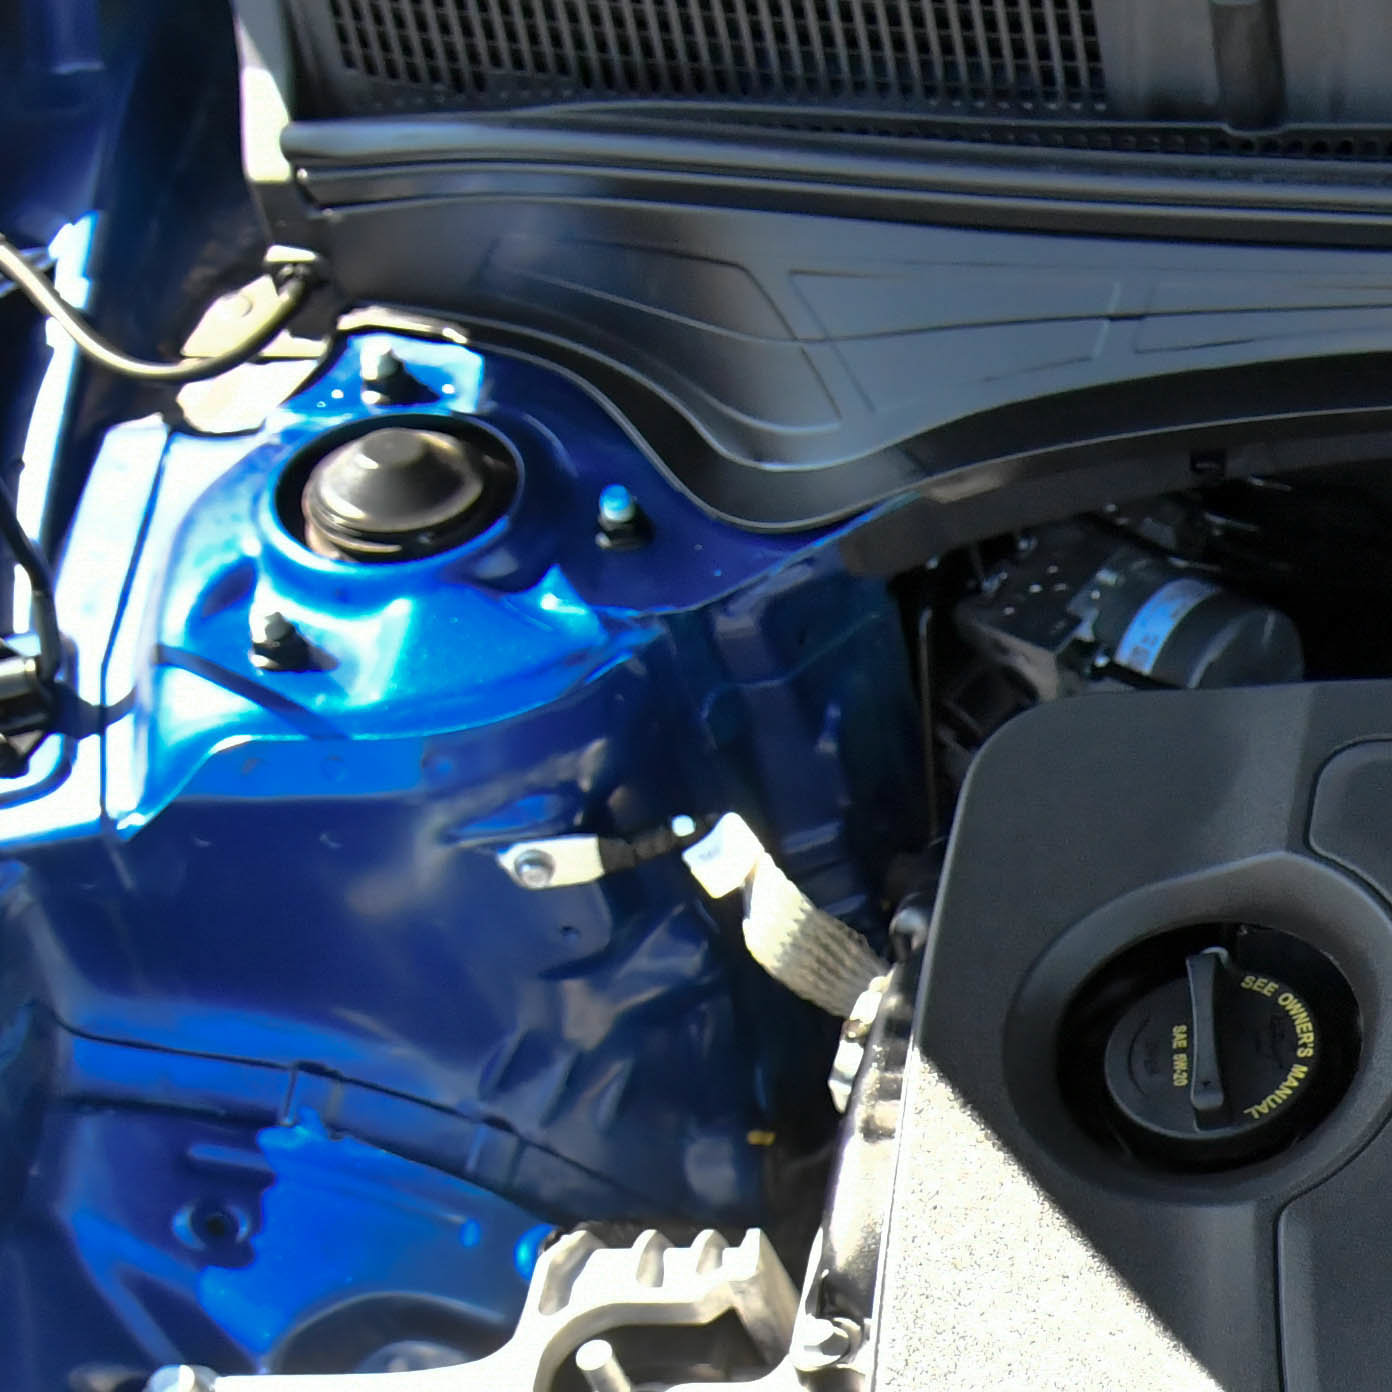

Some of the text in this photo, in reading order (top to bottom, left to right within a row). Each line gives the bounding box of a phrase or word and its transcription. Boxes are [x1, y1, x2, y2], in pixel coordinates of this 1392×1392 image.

[1172, 1025, 1188, 1086] SAE 0W-20
[1241, 975, 1314, 1119] SEE OWNER'S MANUAL
